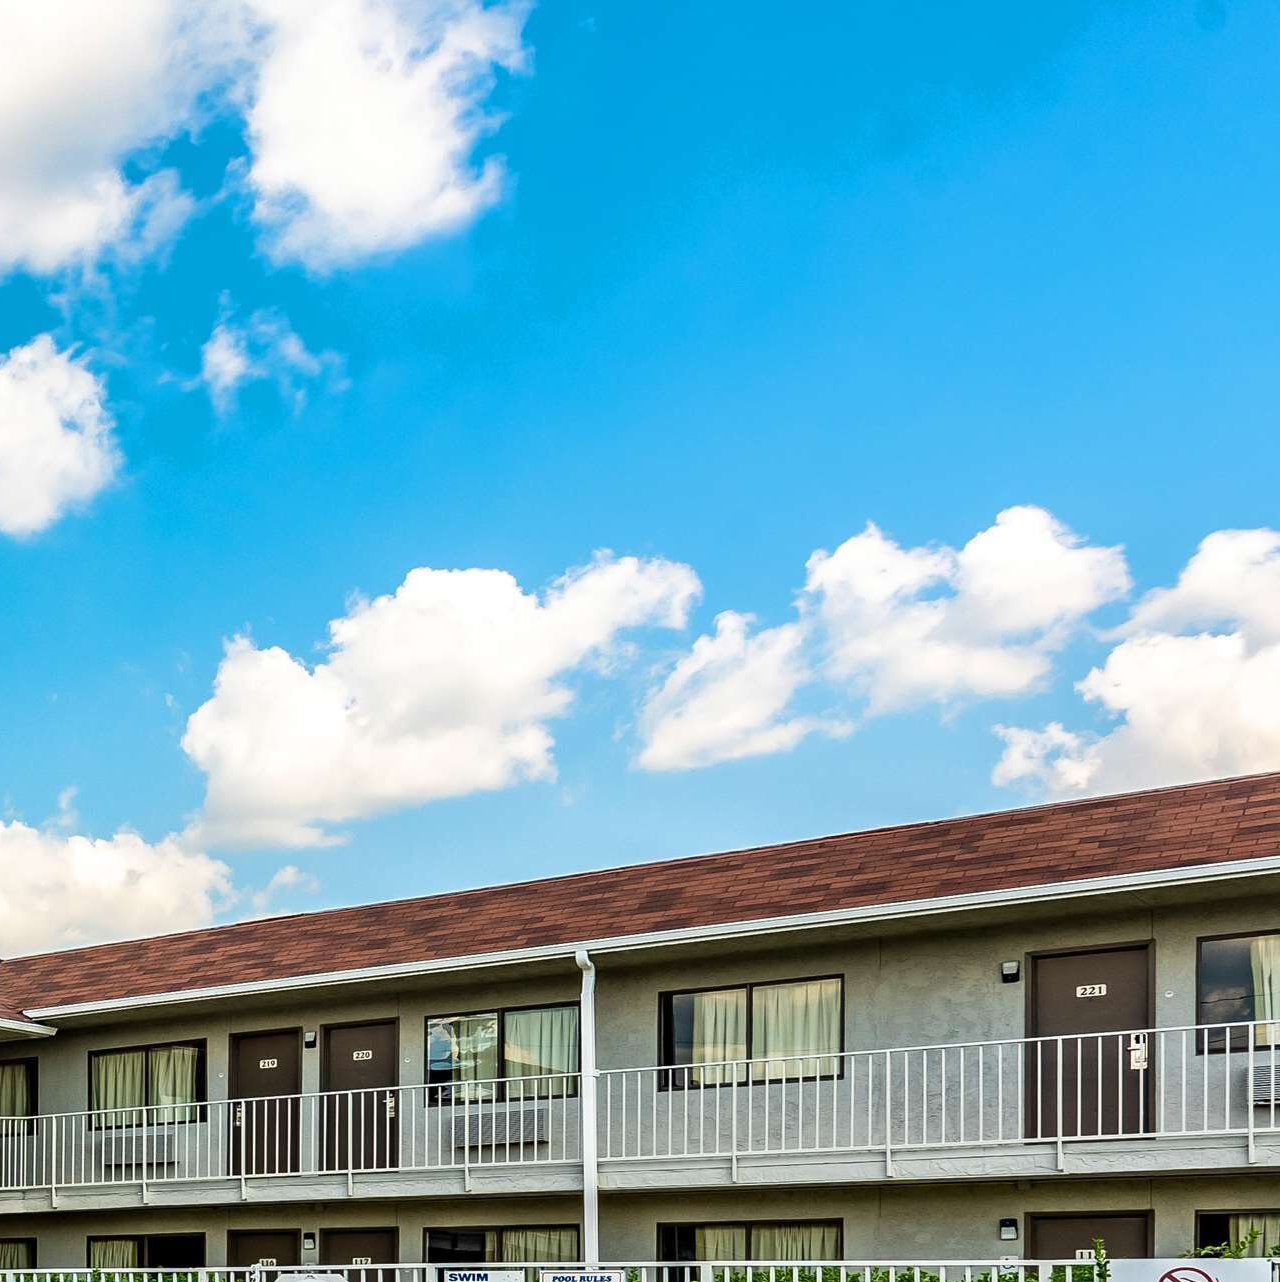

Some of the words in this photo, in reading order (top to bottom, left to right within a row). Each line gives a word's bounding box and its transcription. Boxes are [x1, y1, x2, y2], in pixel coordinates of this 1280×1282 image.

[1081, 986, 1102, 996] 221
[355, 1051, 370, 1059] 220
[262, 1060, 276, 1068] 219
[448, 1273, 489, 1281] SWIM
[552, 1275, 578, 1282] POOL
[579, 1275, 612, 1282] RULES
